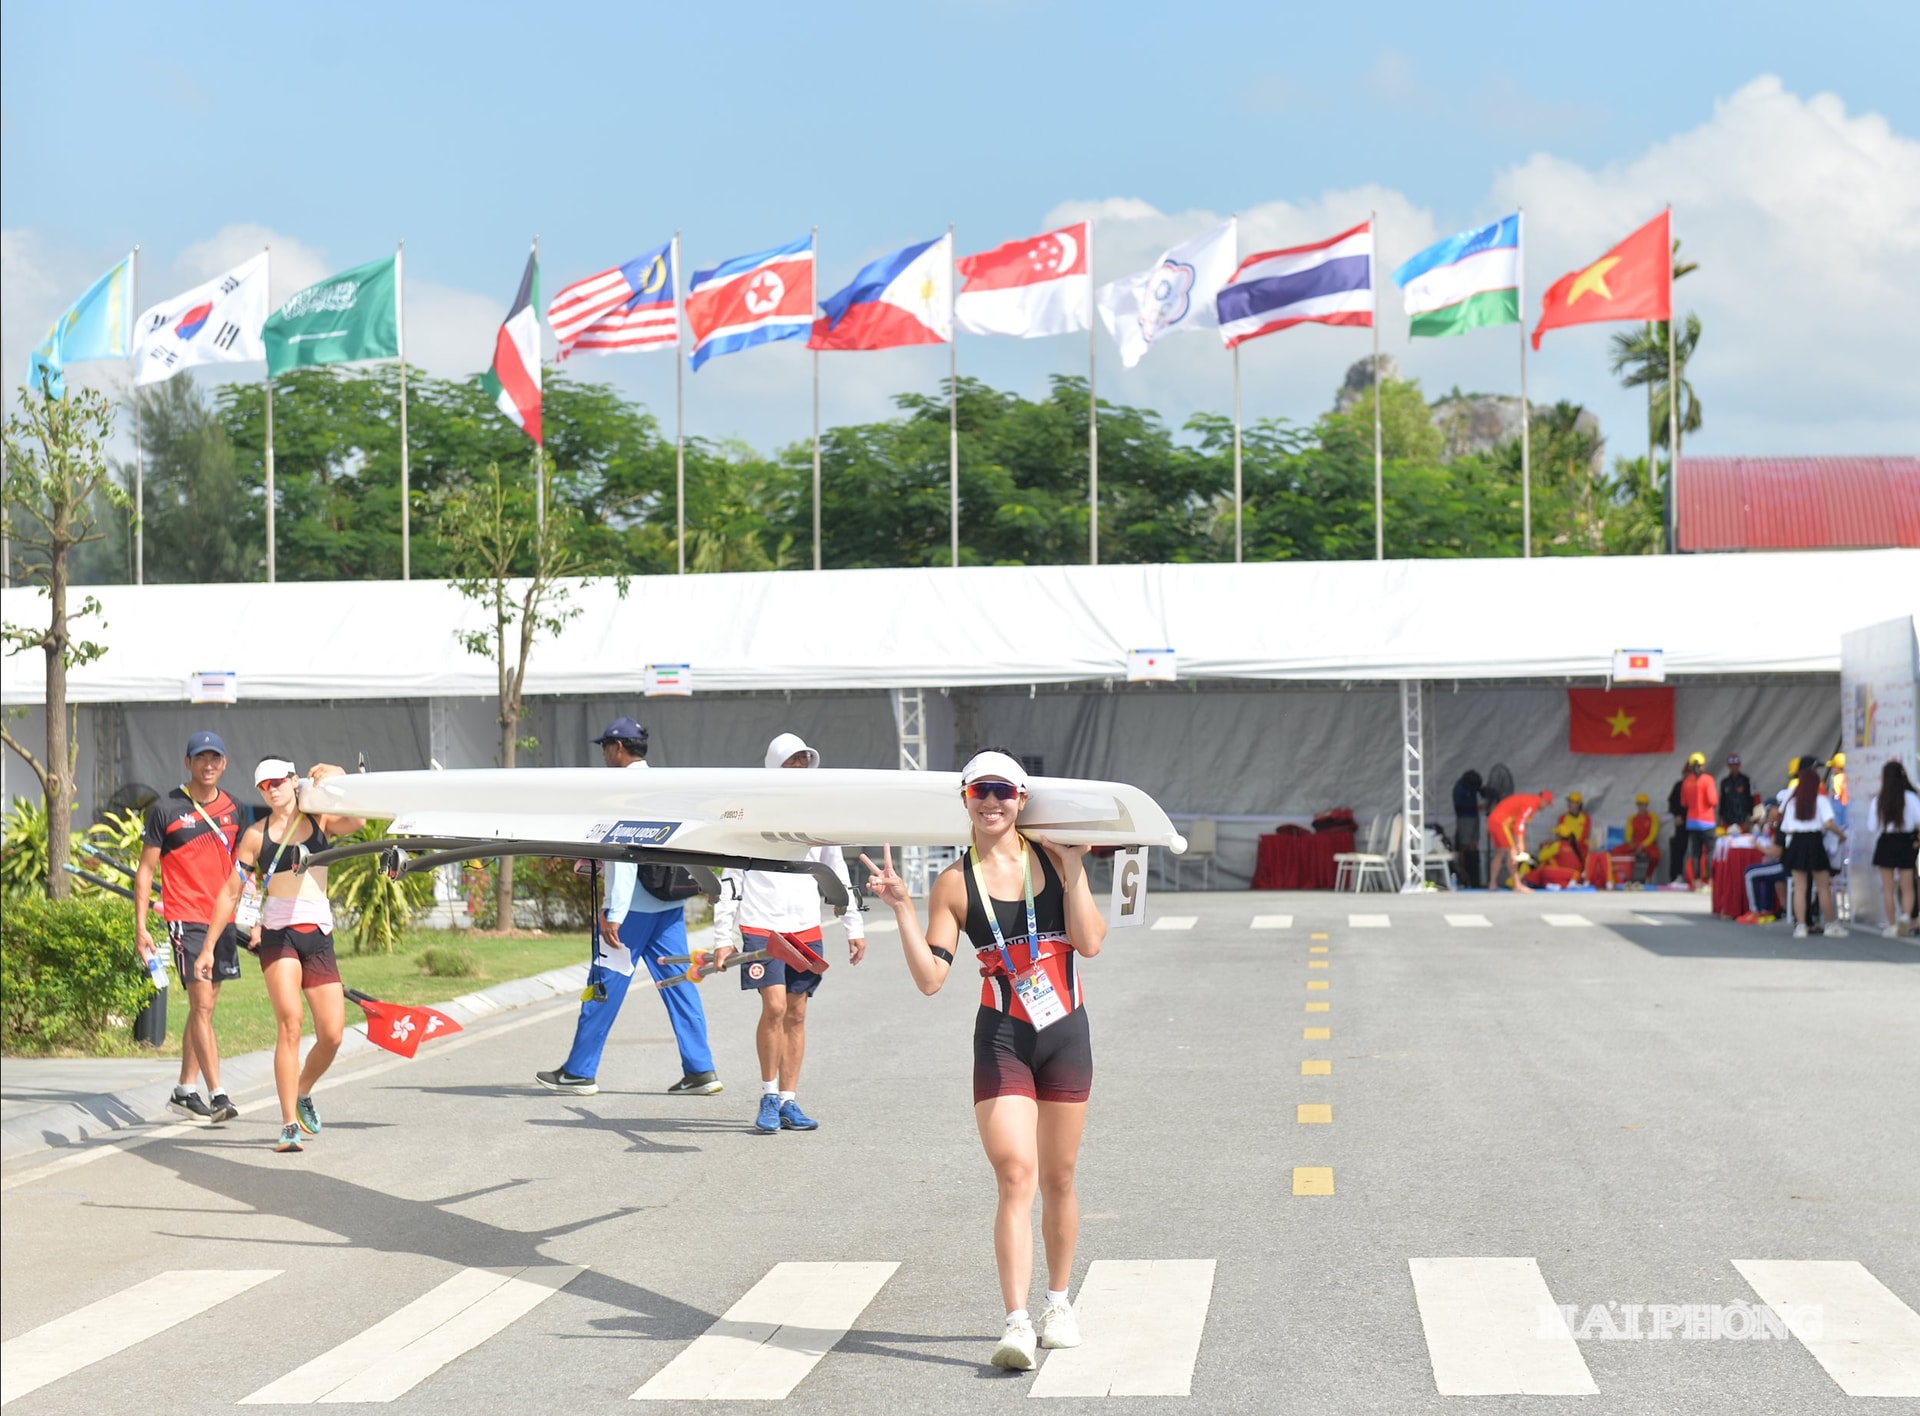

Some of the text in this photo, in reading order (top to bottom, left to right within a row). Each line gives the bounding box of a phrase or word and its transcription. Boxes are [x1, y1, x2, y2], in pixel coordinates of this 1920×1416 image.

[609, 824, 639, 840] rowing
[634, 827, 660, 840] asian
[1121, 860, 1140, 916] 5
